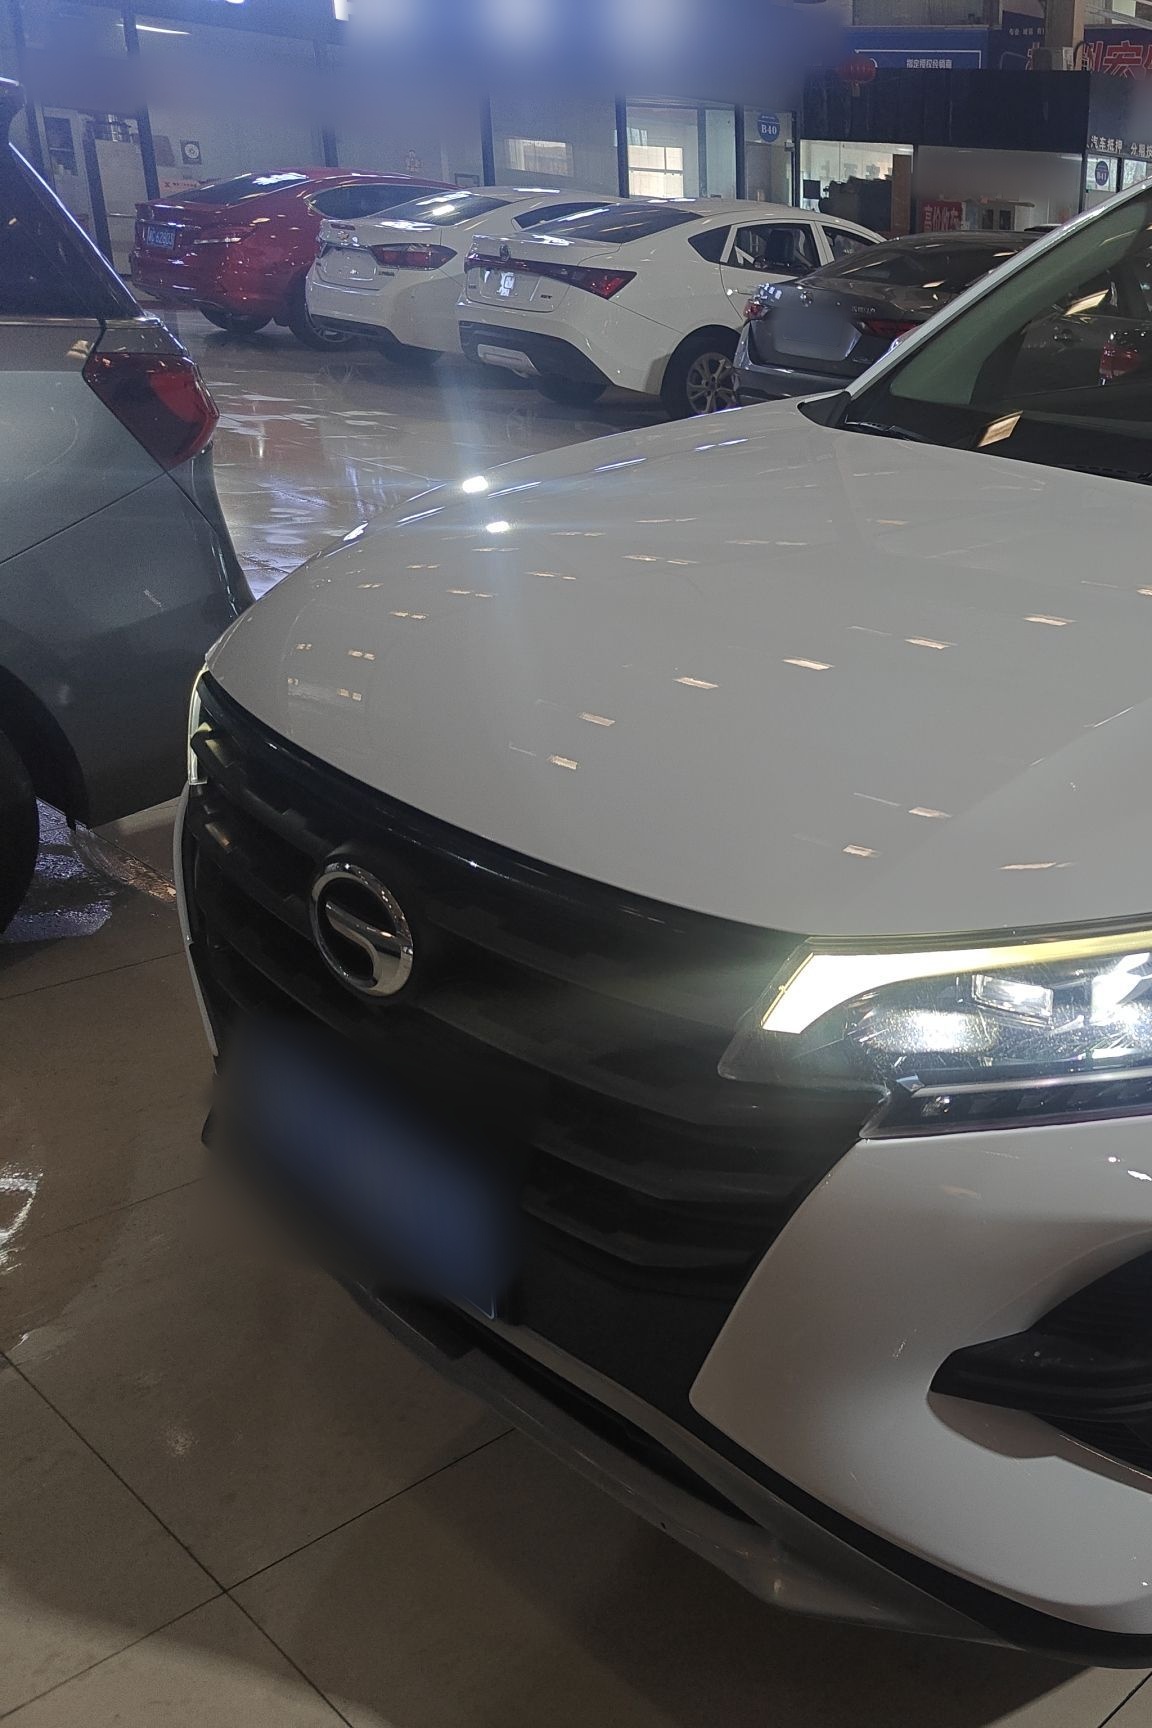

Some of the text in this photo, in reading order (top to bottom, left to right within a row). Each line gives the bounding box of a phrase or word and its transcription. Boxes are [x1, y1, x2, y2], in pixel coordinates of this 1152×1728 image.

[761, 124, 777, 135] B40
[1087, 135, 1123, 154] 汽车抵押
